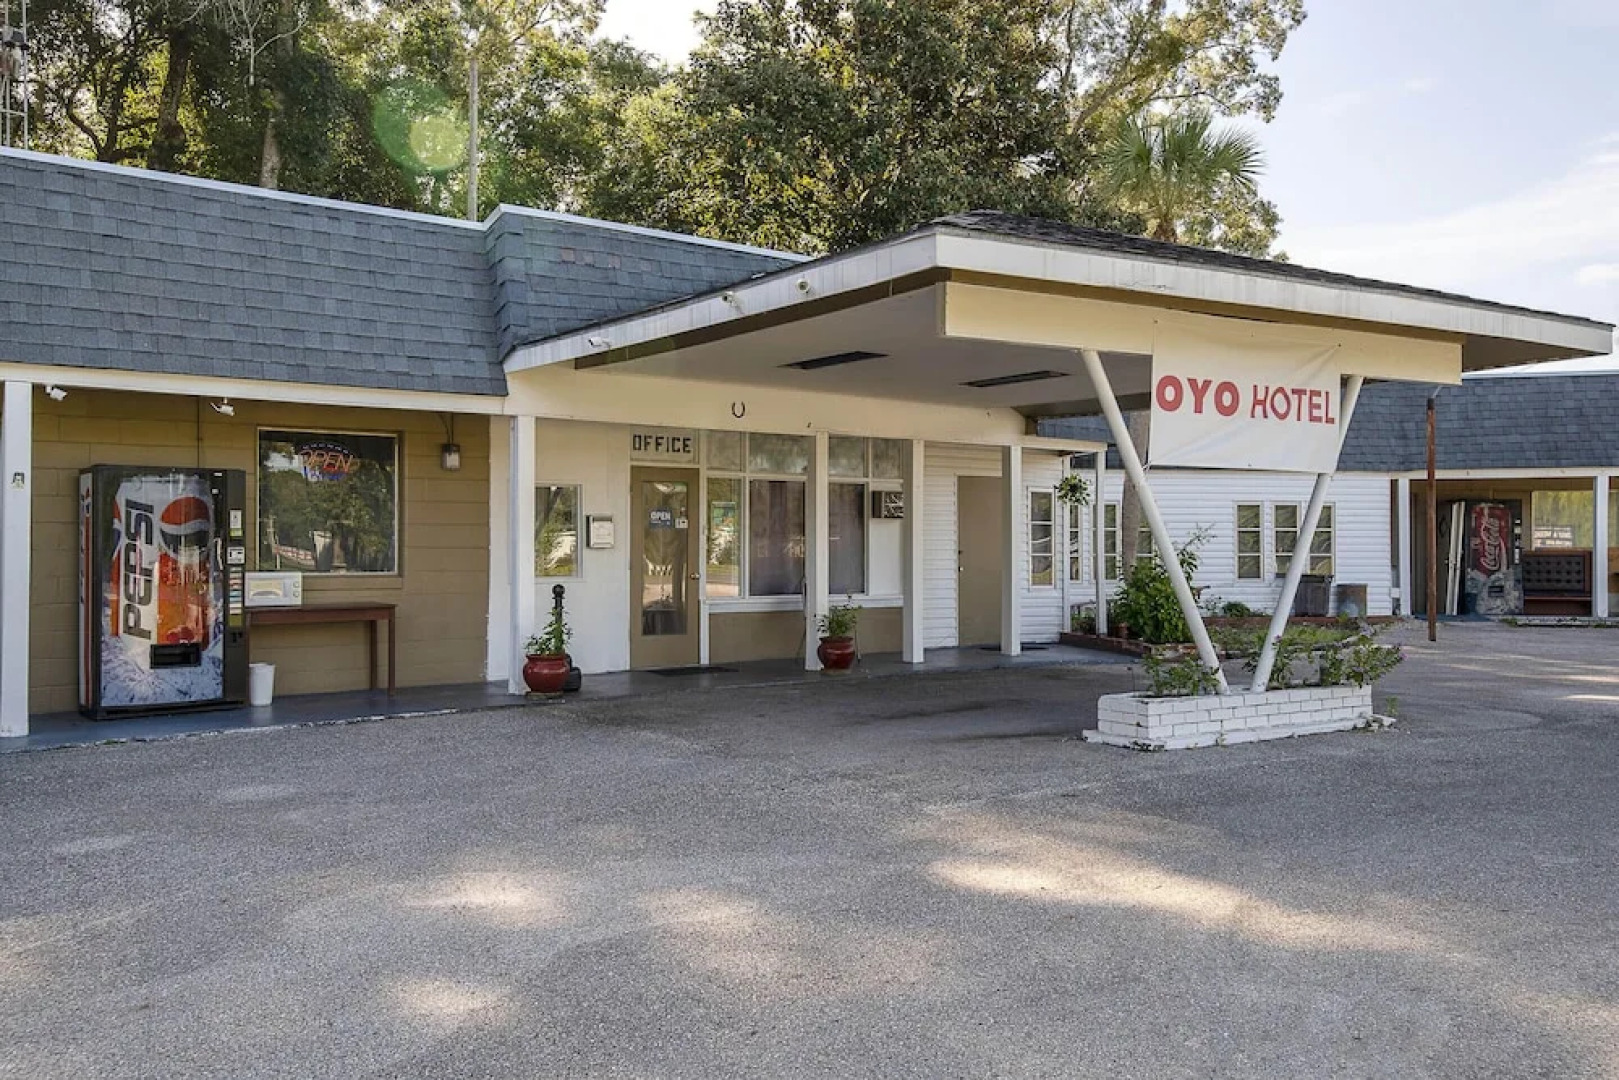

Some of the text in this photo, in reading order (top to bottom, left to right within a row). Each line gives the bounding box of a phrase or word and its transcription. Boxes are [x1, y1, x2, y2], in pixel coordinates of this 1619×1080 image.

[1155, 374, 1335, 425] OYO HOTEL
[632, 434, 692, 453] OFFICE
[650, 511, 671, 521] OPEN
[122, 498, 155, 640] PEPSI
